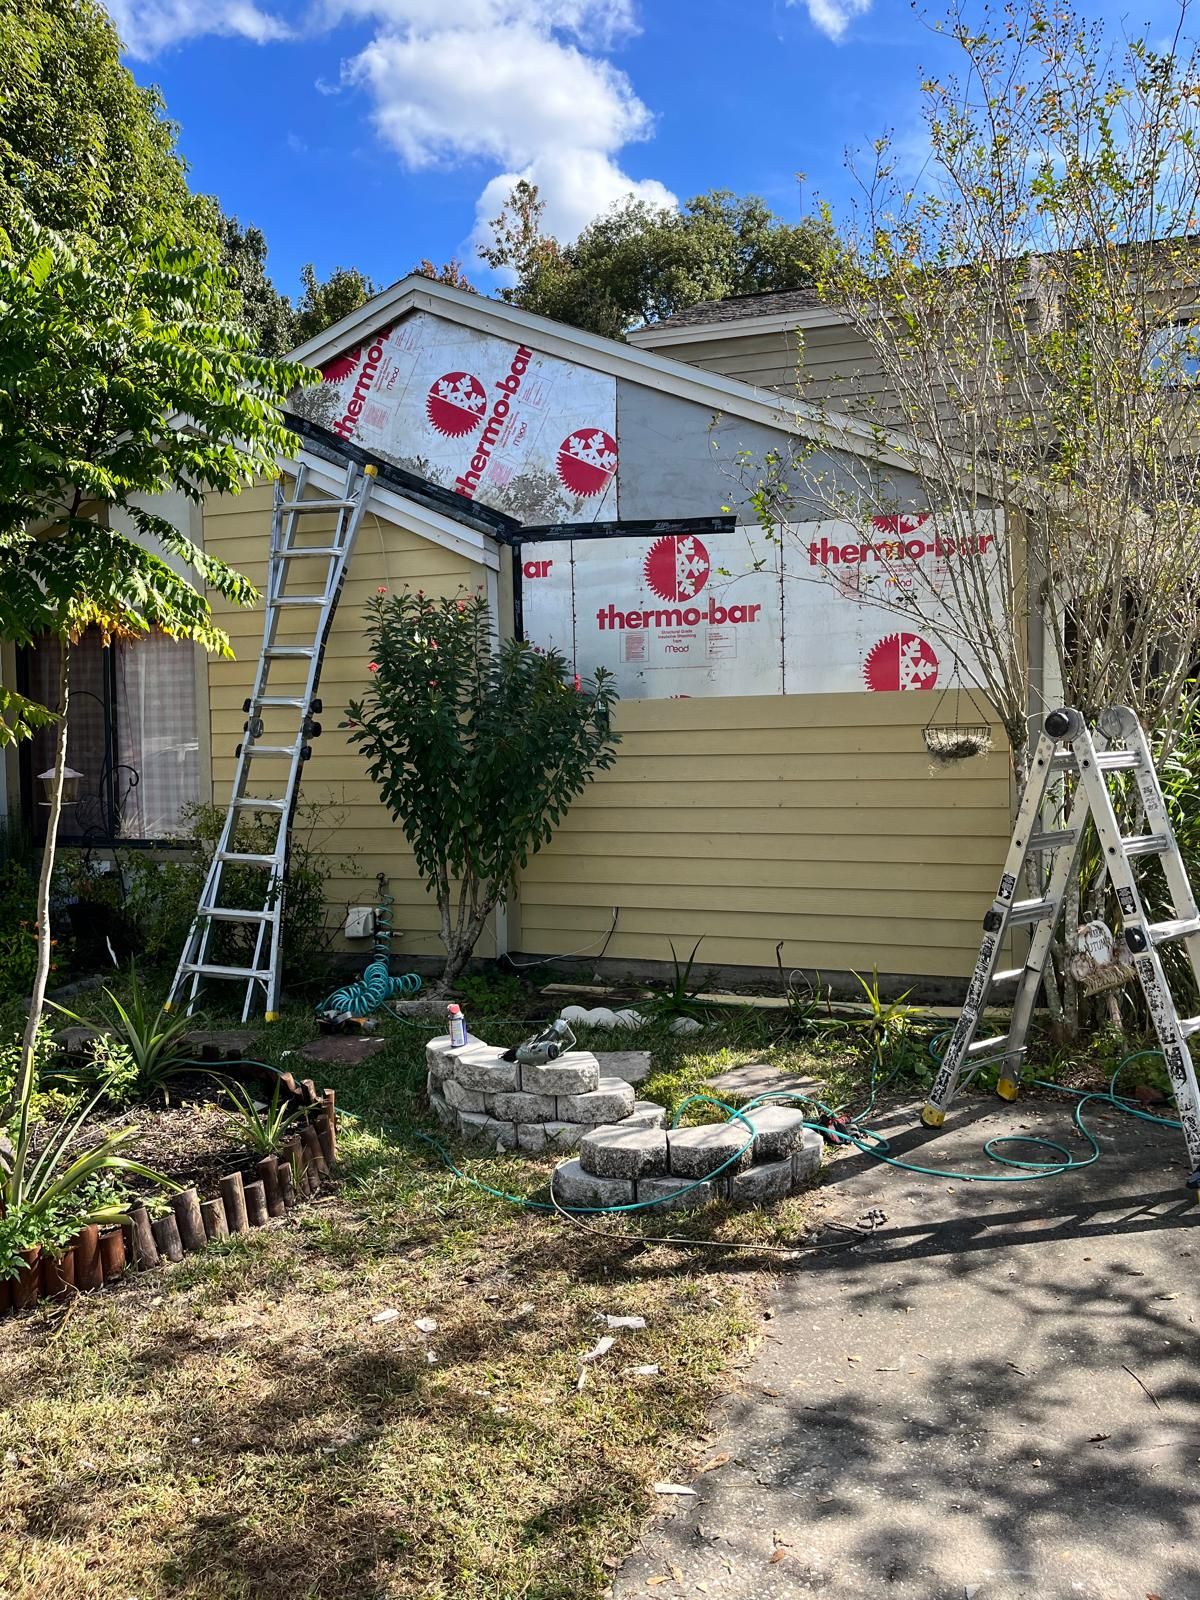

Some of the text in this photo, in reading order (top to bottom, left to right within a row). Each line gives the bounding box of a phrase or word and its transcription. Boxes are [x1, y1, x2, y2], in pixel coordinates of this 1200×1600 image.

[454, 344, 533, 500] thermo-bar
[522, 560, 552, 578] ar
[596, 598, 761, 630] thermo-bar
